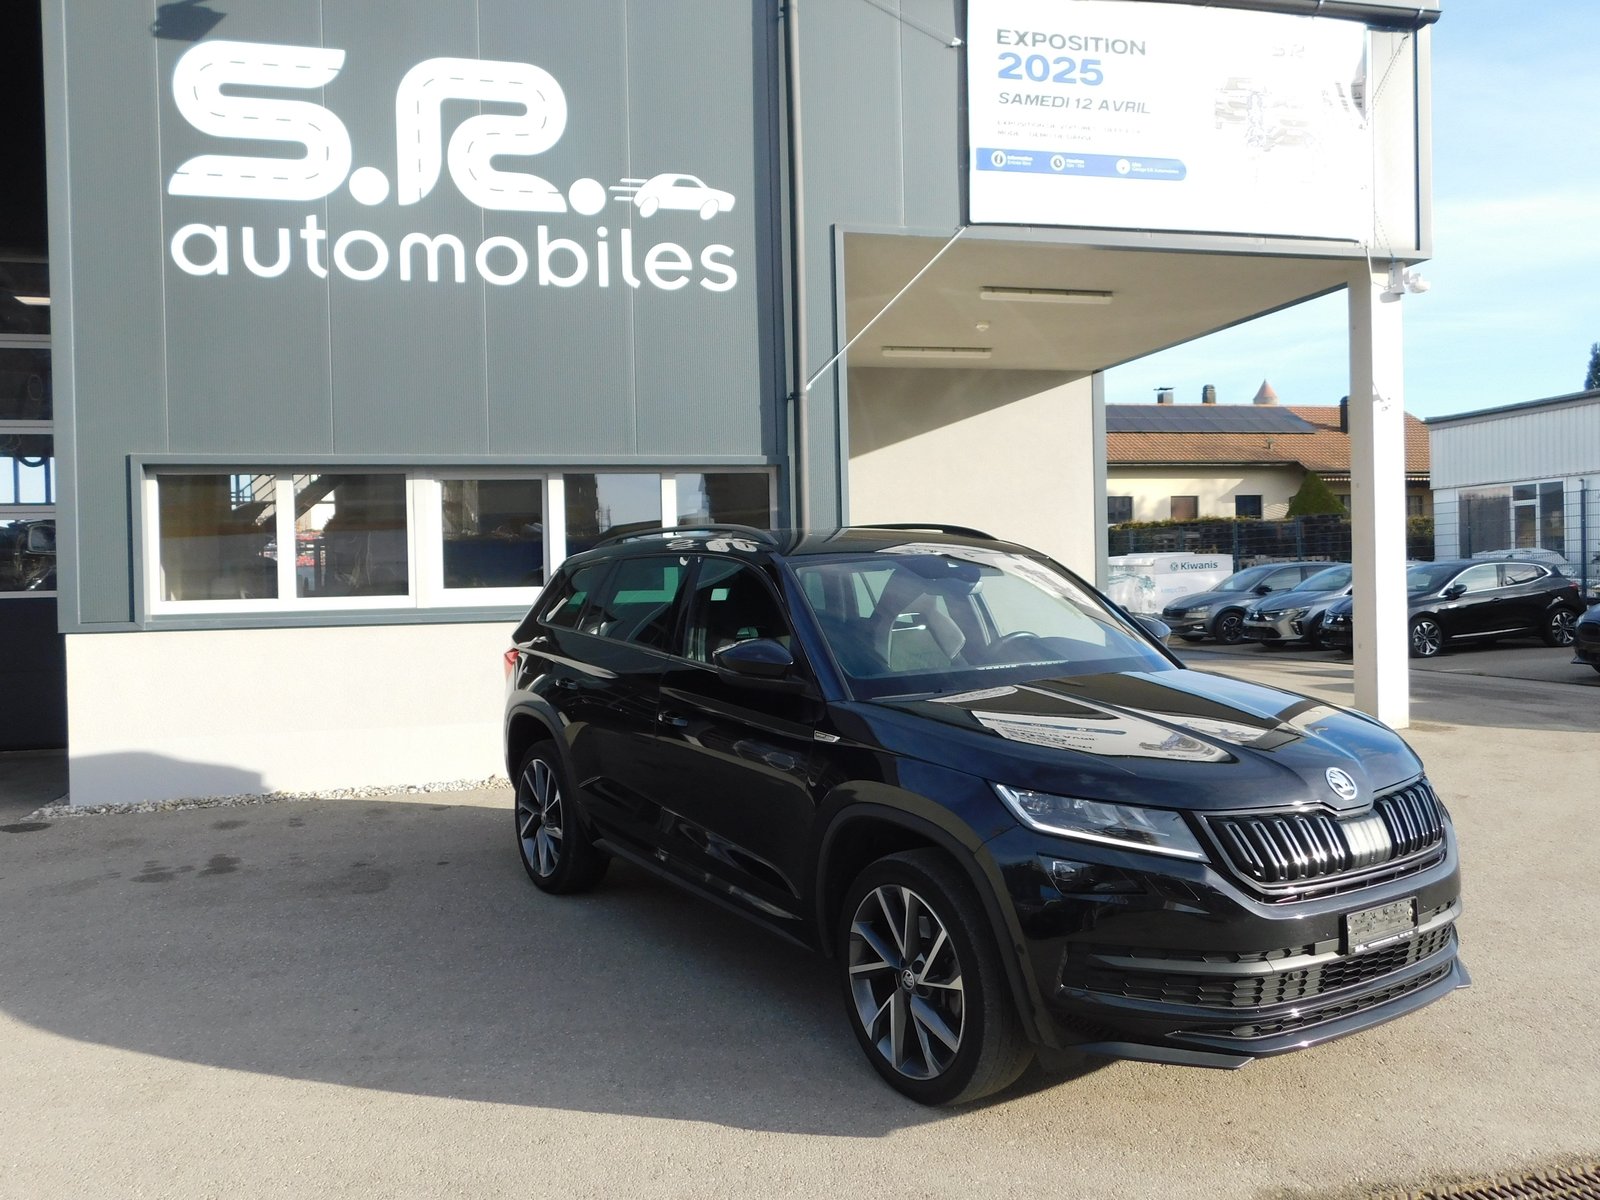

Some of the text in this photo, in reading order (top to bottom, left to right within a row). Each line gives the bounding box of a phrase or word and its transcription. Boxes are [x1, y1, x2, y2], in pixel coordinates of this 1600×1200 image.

[996, 28, 1146, 56] EXPOSITION
[997, 51, 1104, 86] 2025
[998, 92, 1151, 114] SAMEDI 12 AVRIL
[168, 40, 607, 216] S.R.
[170, 214, 738, 293] automobiles
[1180, 561, 1218, 570] Kiwanis
